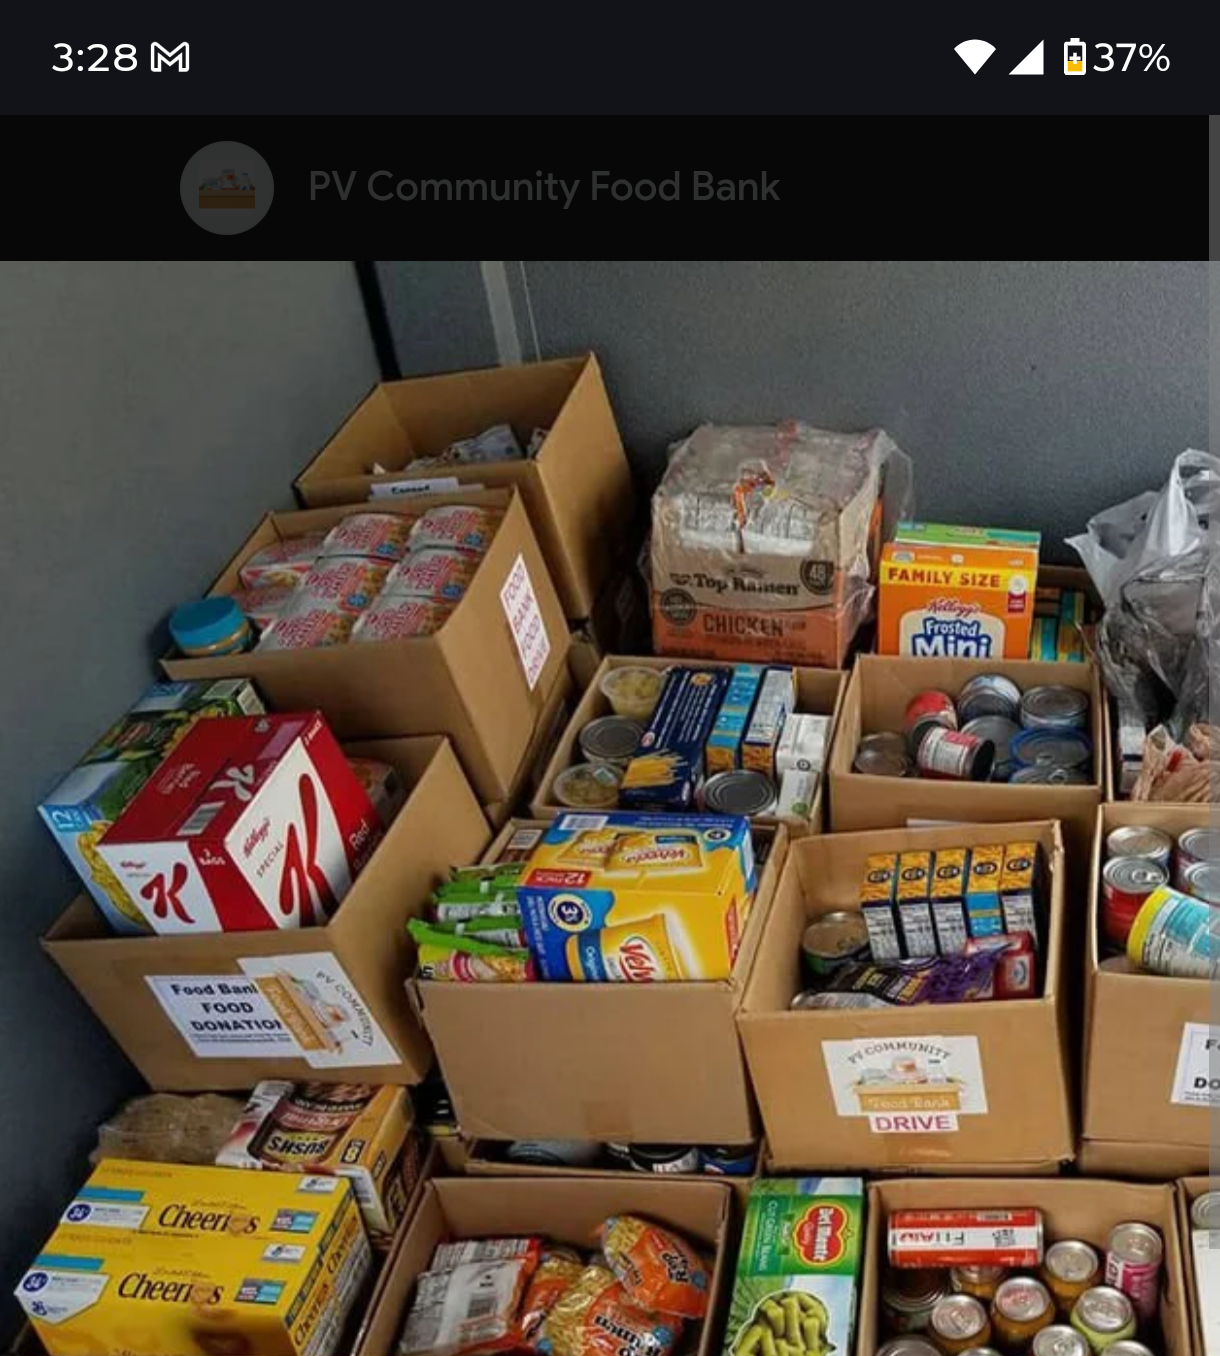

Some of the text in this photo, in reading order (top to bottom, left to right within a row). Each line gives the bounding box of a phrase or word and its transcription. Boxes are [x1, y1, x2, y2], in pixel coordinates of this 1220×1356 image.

[52, 43, 137, 72] 3:28
[1093, 43, 1170, 73] 37%
[310, 169, 781, 210] PV Community Food Bank
[693, 573, 728, 593] Top
[888, 567, 1001, 588] FAMILY SIZE
[703, 613, 784, 637] CHICKEN
[925, 618, 978, 636] Frosted
[914, 635, 991, 658] Mini
[256, 842, 285, 878] SPECIAL
[564, 872, 587, 884] 12
[141, 862, 195, 923] K
[170, 984, 215, 996] Food
[201, 1002, 254, 1014] FOOD
[864, 1041, 953, 1060] COMMUNITY
[875, 1115, 952, 1132] DRIVE
[158, 1203, 261, 1235] Cheerios
[118, 1271, 223, 1305] Cheerios
